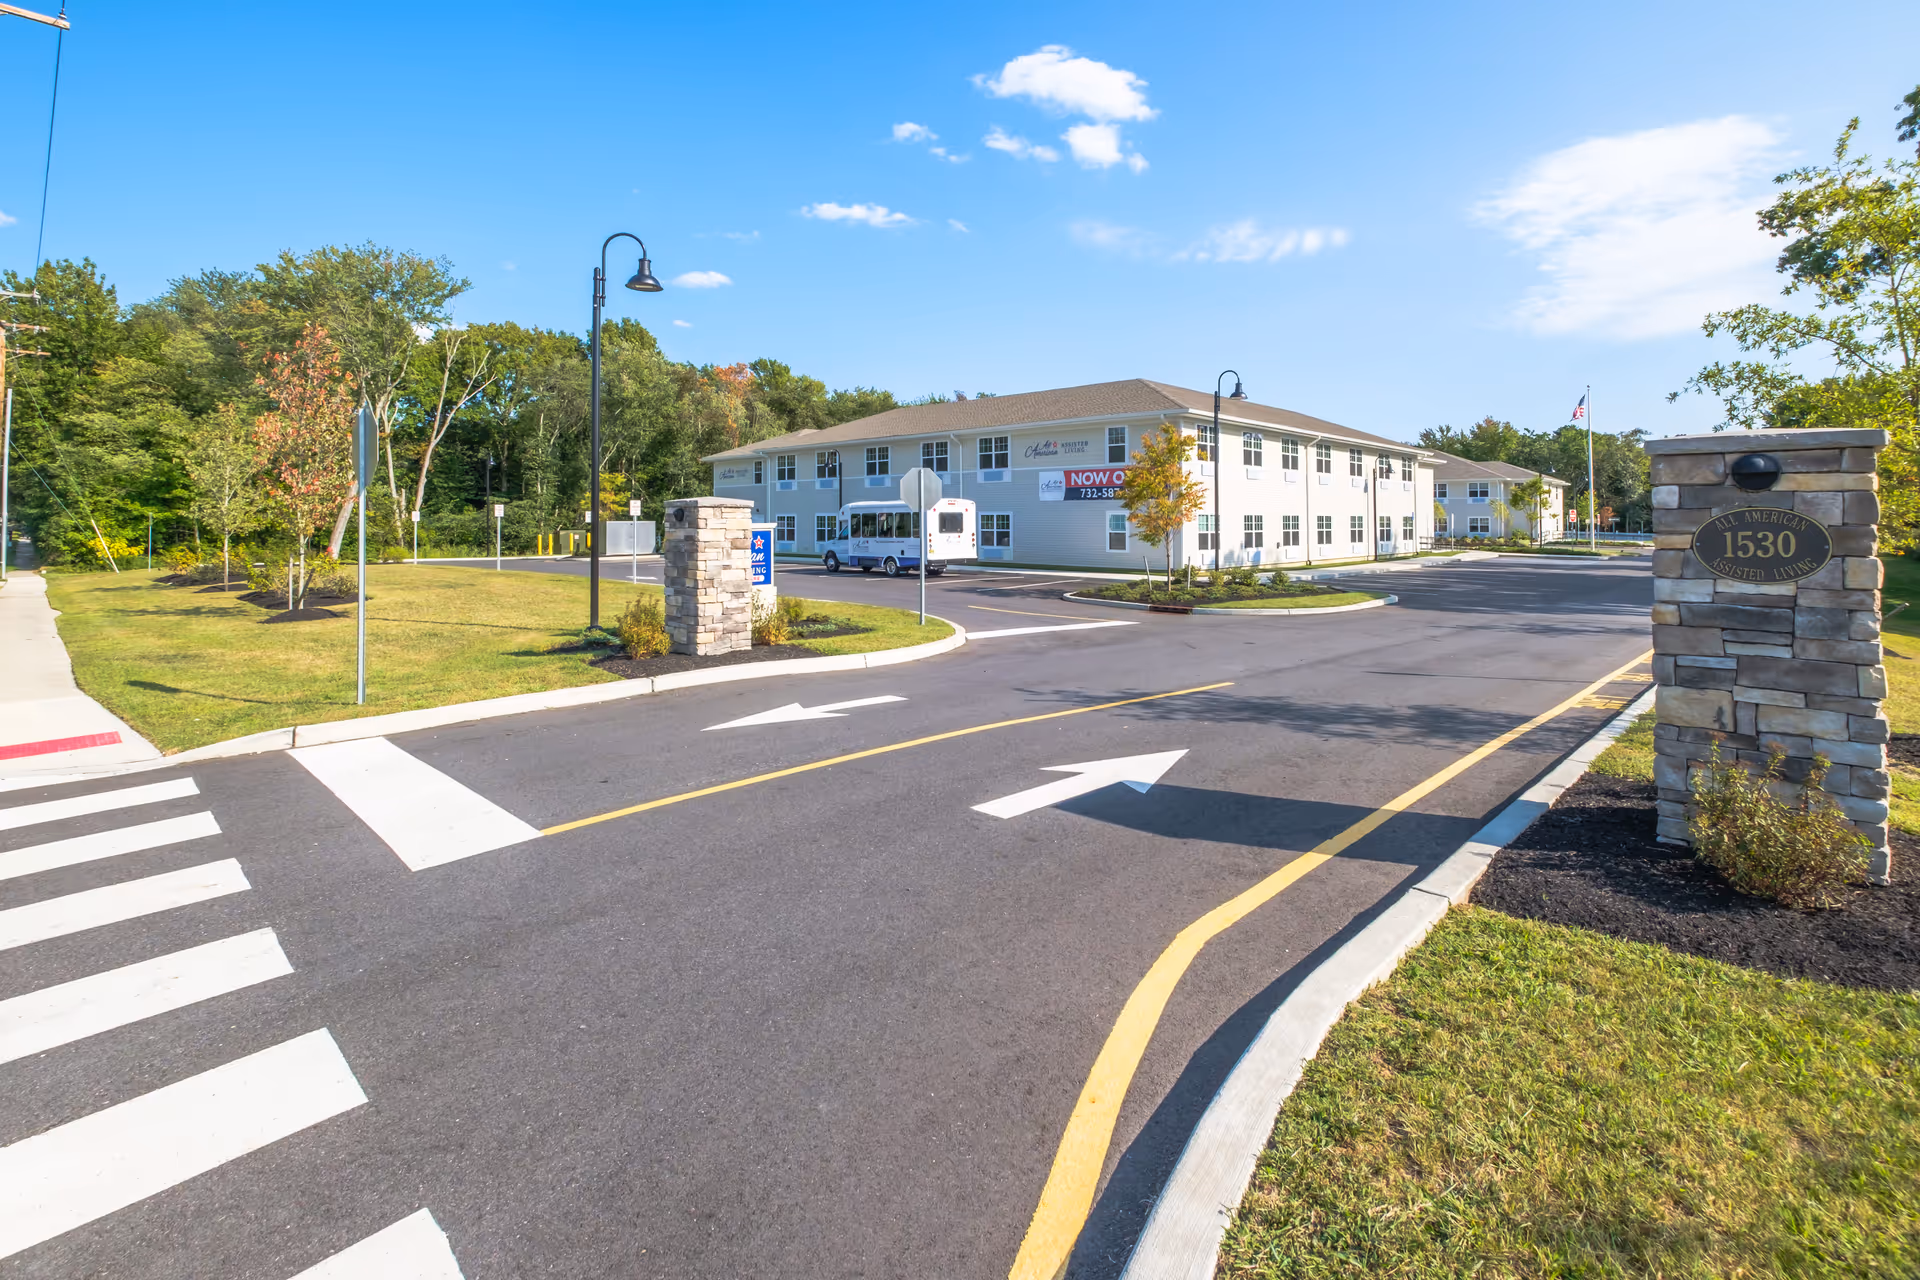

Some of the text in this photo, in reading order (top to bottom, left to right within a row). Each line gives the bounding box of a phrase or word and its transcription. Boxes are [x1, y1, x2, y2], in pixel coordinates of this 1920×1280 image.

[1071, 471, 1110, 485] NOW
[1715, 511, 1810, 532] ALL AMERICAN
[1723, 530, 1796, 558] 1530
[752, 566, 767, 574] ING
[1710, 557, 1817, 580] ASSISTED LIVING
